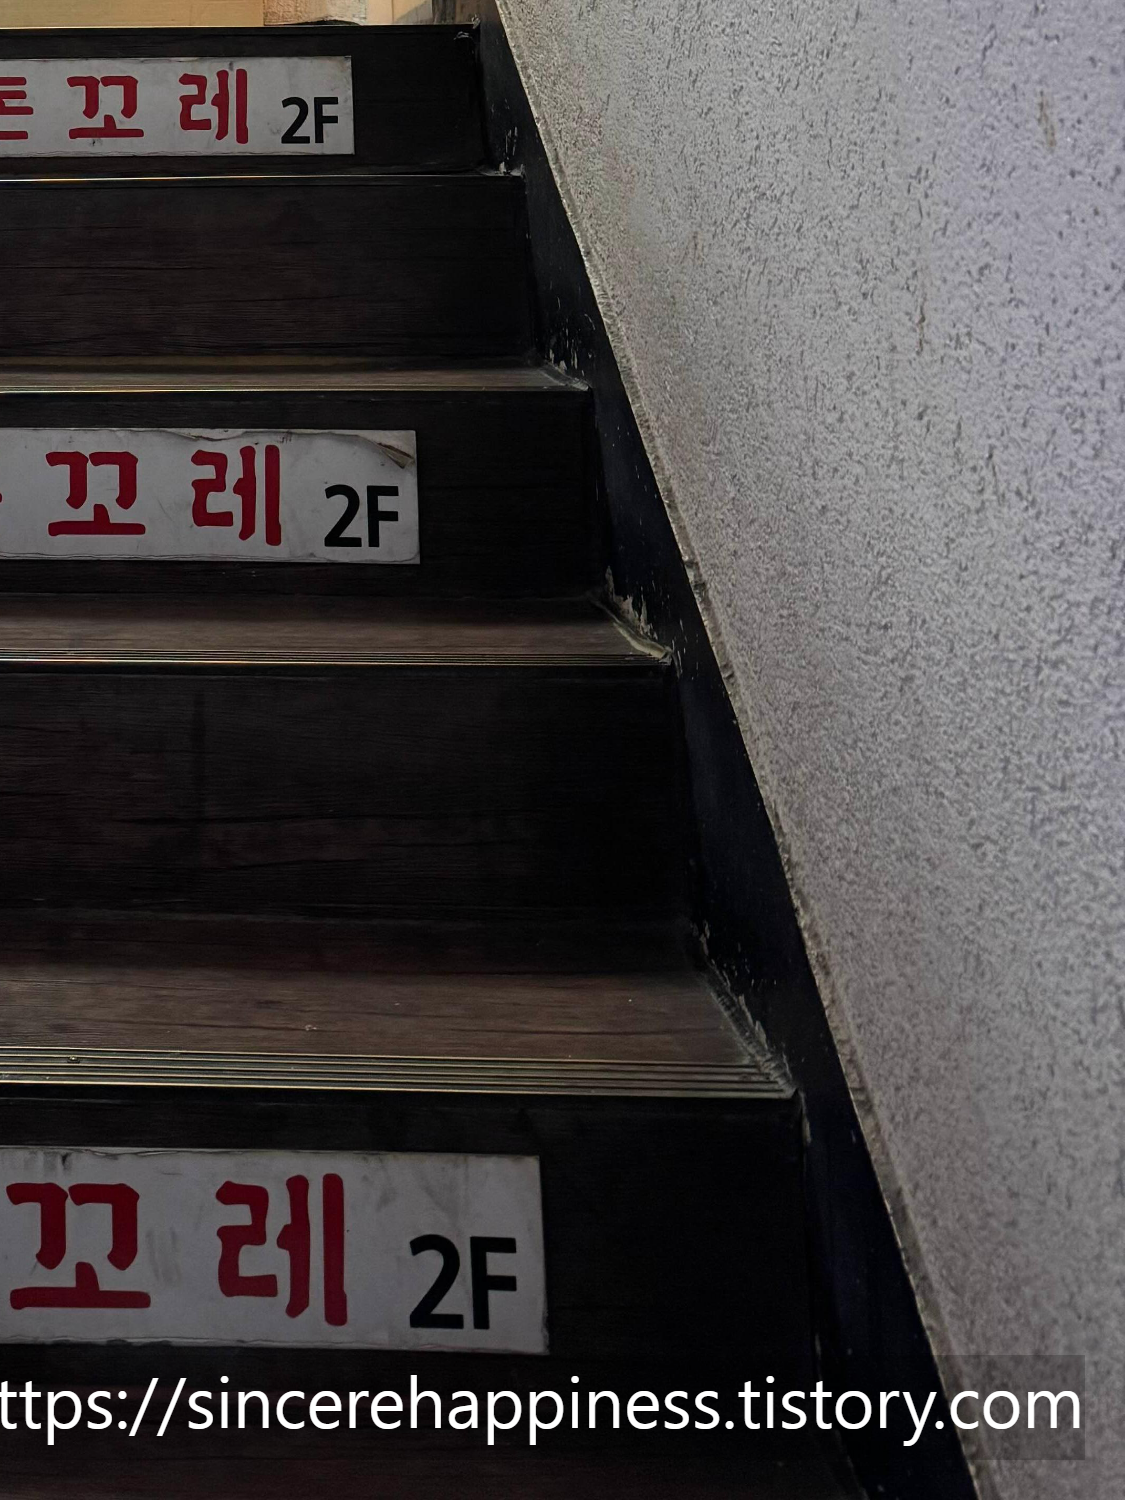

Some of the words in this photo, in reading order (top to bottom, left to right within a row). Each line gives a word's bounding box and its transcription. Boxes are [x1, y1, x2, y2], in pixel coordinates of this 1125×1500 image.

[281, 97, 339, 144] 2F
[323, 484, 399, 548] 2F
[408, 1235, 518, 1330] 2F
